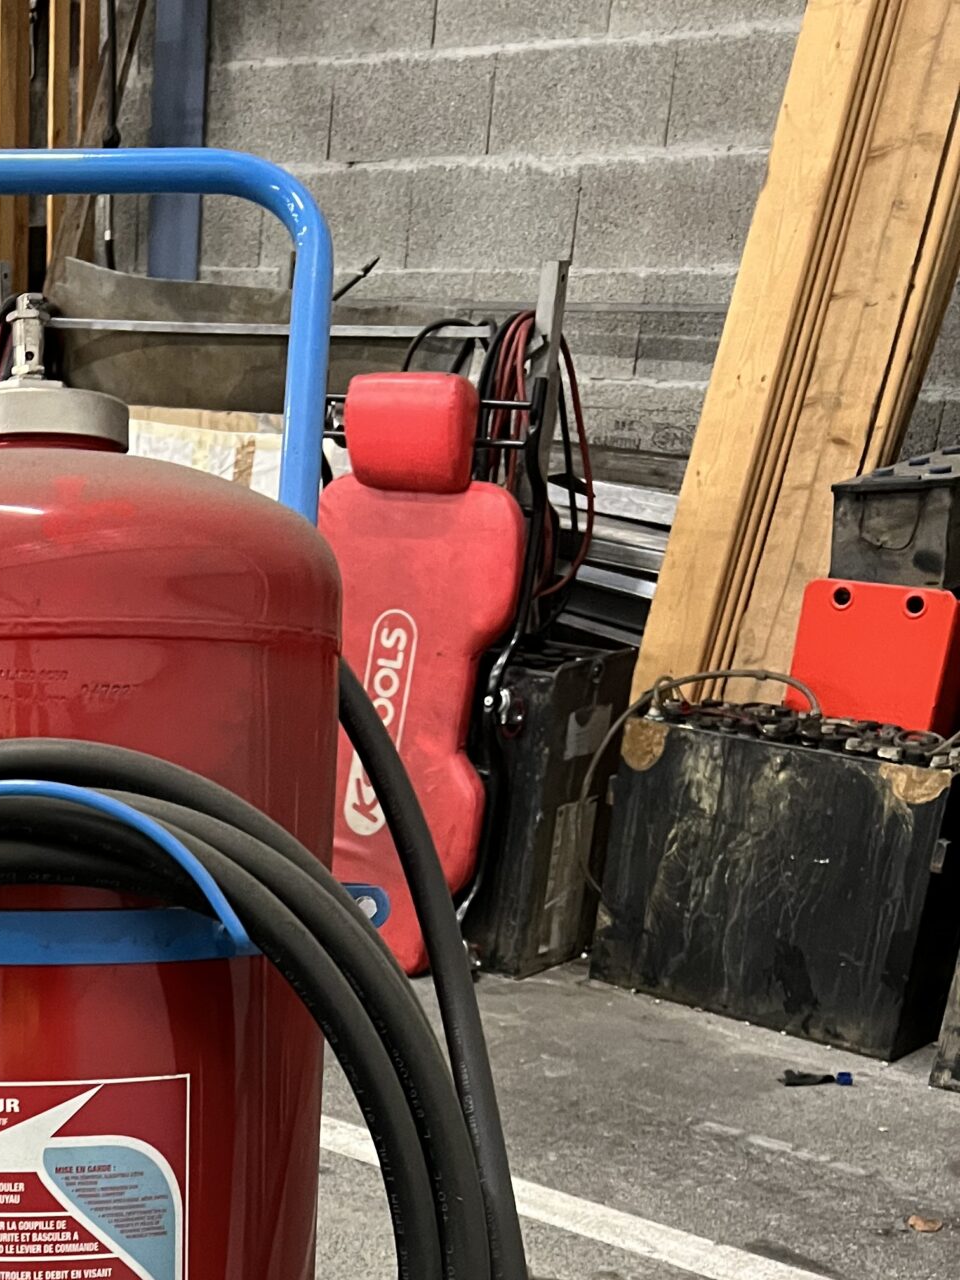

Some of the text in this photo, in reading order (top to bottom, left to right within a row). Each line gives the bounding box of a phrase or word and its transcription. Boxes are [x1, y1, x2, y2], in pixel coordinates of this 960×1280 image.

[369, 627, 408, 727] OOLS
[6, 1221, 17, 1230] LA
[18, 1220, 54, 1230] GOUPILLE
[56, 1220, 67, 1230] DE
[21, 1232, 31, 1242] ET
[32, 1232, 71, 1242] BASCULER
[73, 1231, 79, 1241] A
[5, 1245, 15, 1254] LE
[16, 1244, 43, 1254] LEVIER
[44, 1244, 54, 1253] DE
[55, 1242, 99, 1253] COMMANDE
[33, 1271, 43, 1280] LE
[45, 1269, 69, 1280] DEBIT
[71, 1268, 82, 1279] EN
[83, 1267, 112, 1278] VISANT
